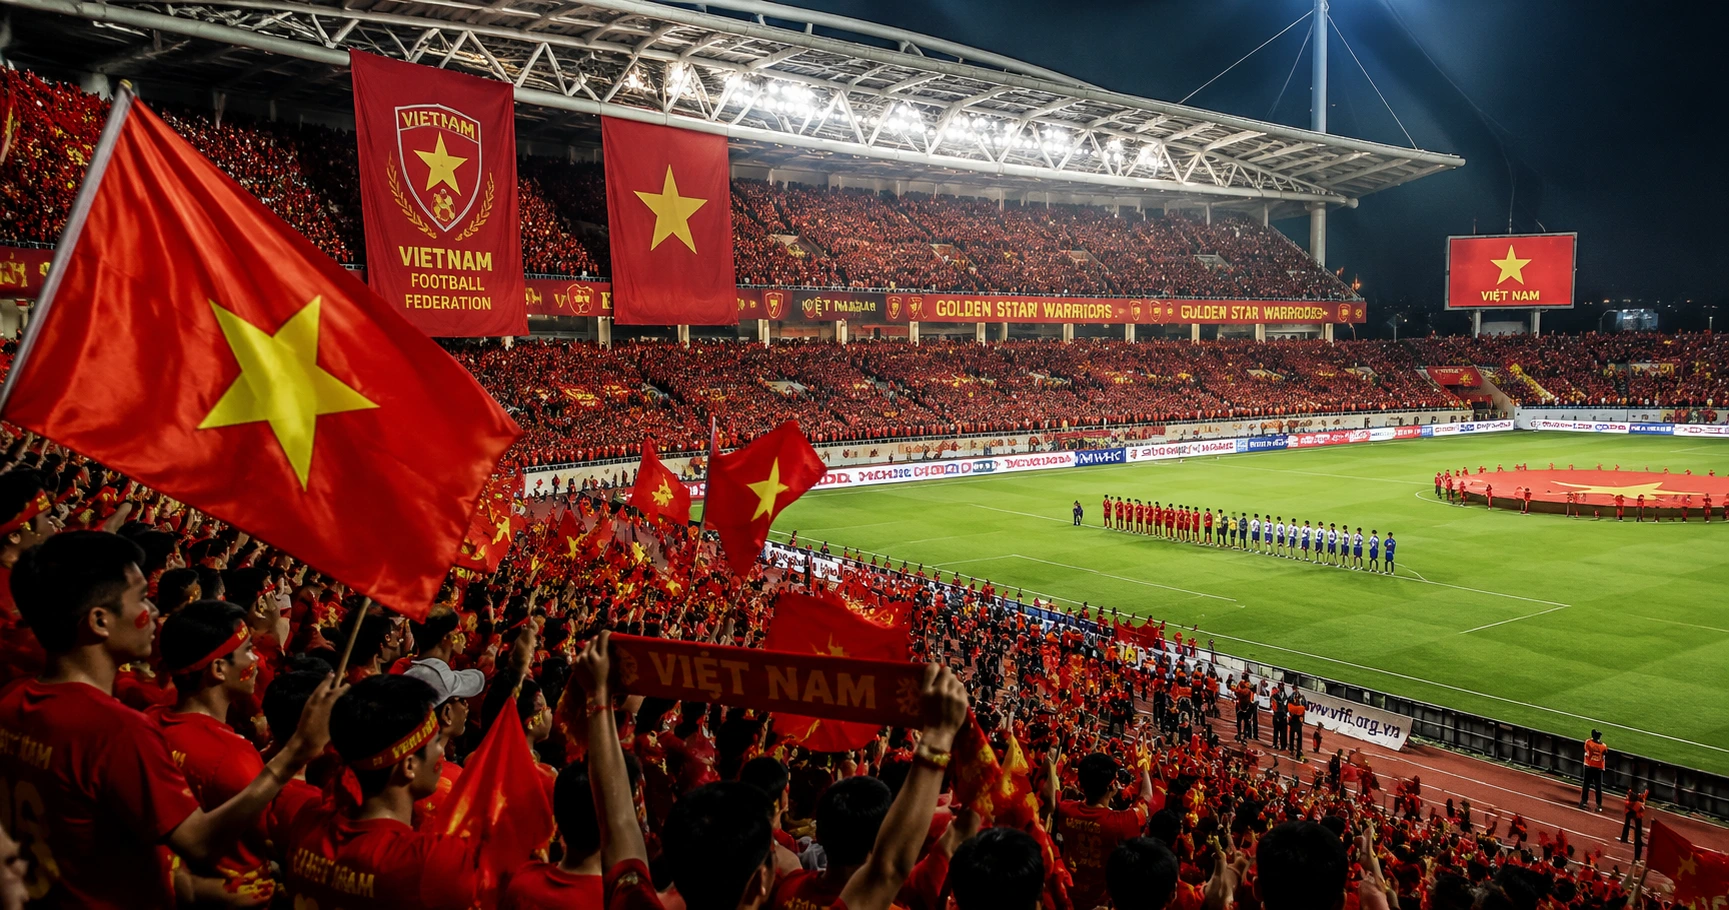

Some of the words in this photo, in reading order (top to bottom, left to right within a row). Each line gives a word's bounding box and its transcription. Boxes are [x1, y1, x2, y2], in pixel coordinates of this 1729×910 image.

[399, 246, 492, 271] VIETNAM
[411, 273, 485, 291] FOOTBALL
[405, 294, 492, 310] FEDERATION
[1512, 290, 1540, 301] NAM
[936, 300, 991, 317] GOLDEN
[1231, 306, 1259, 319] STAR
[765, 664, 876, 710] NAM
